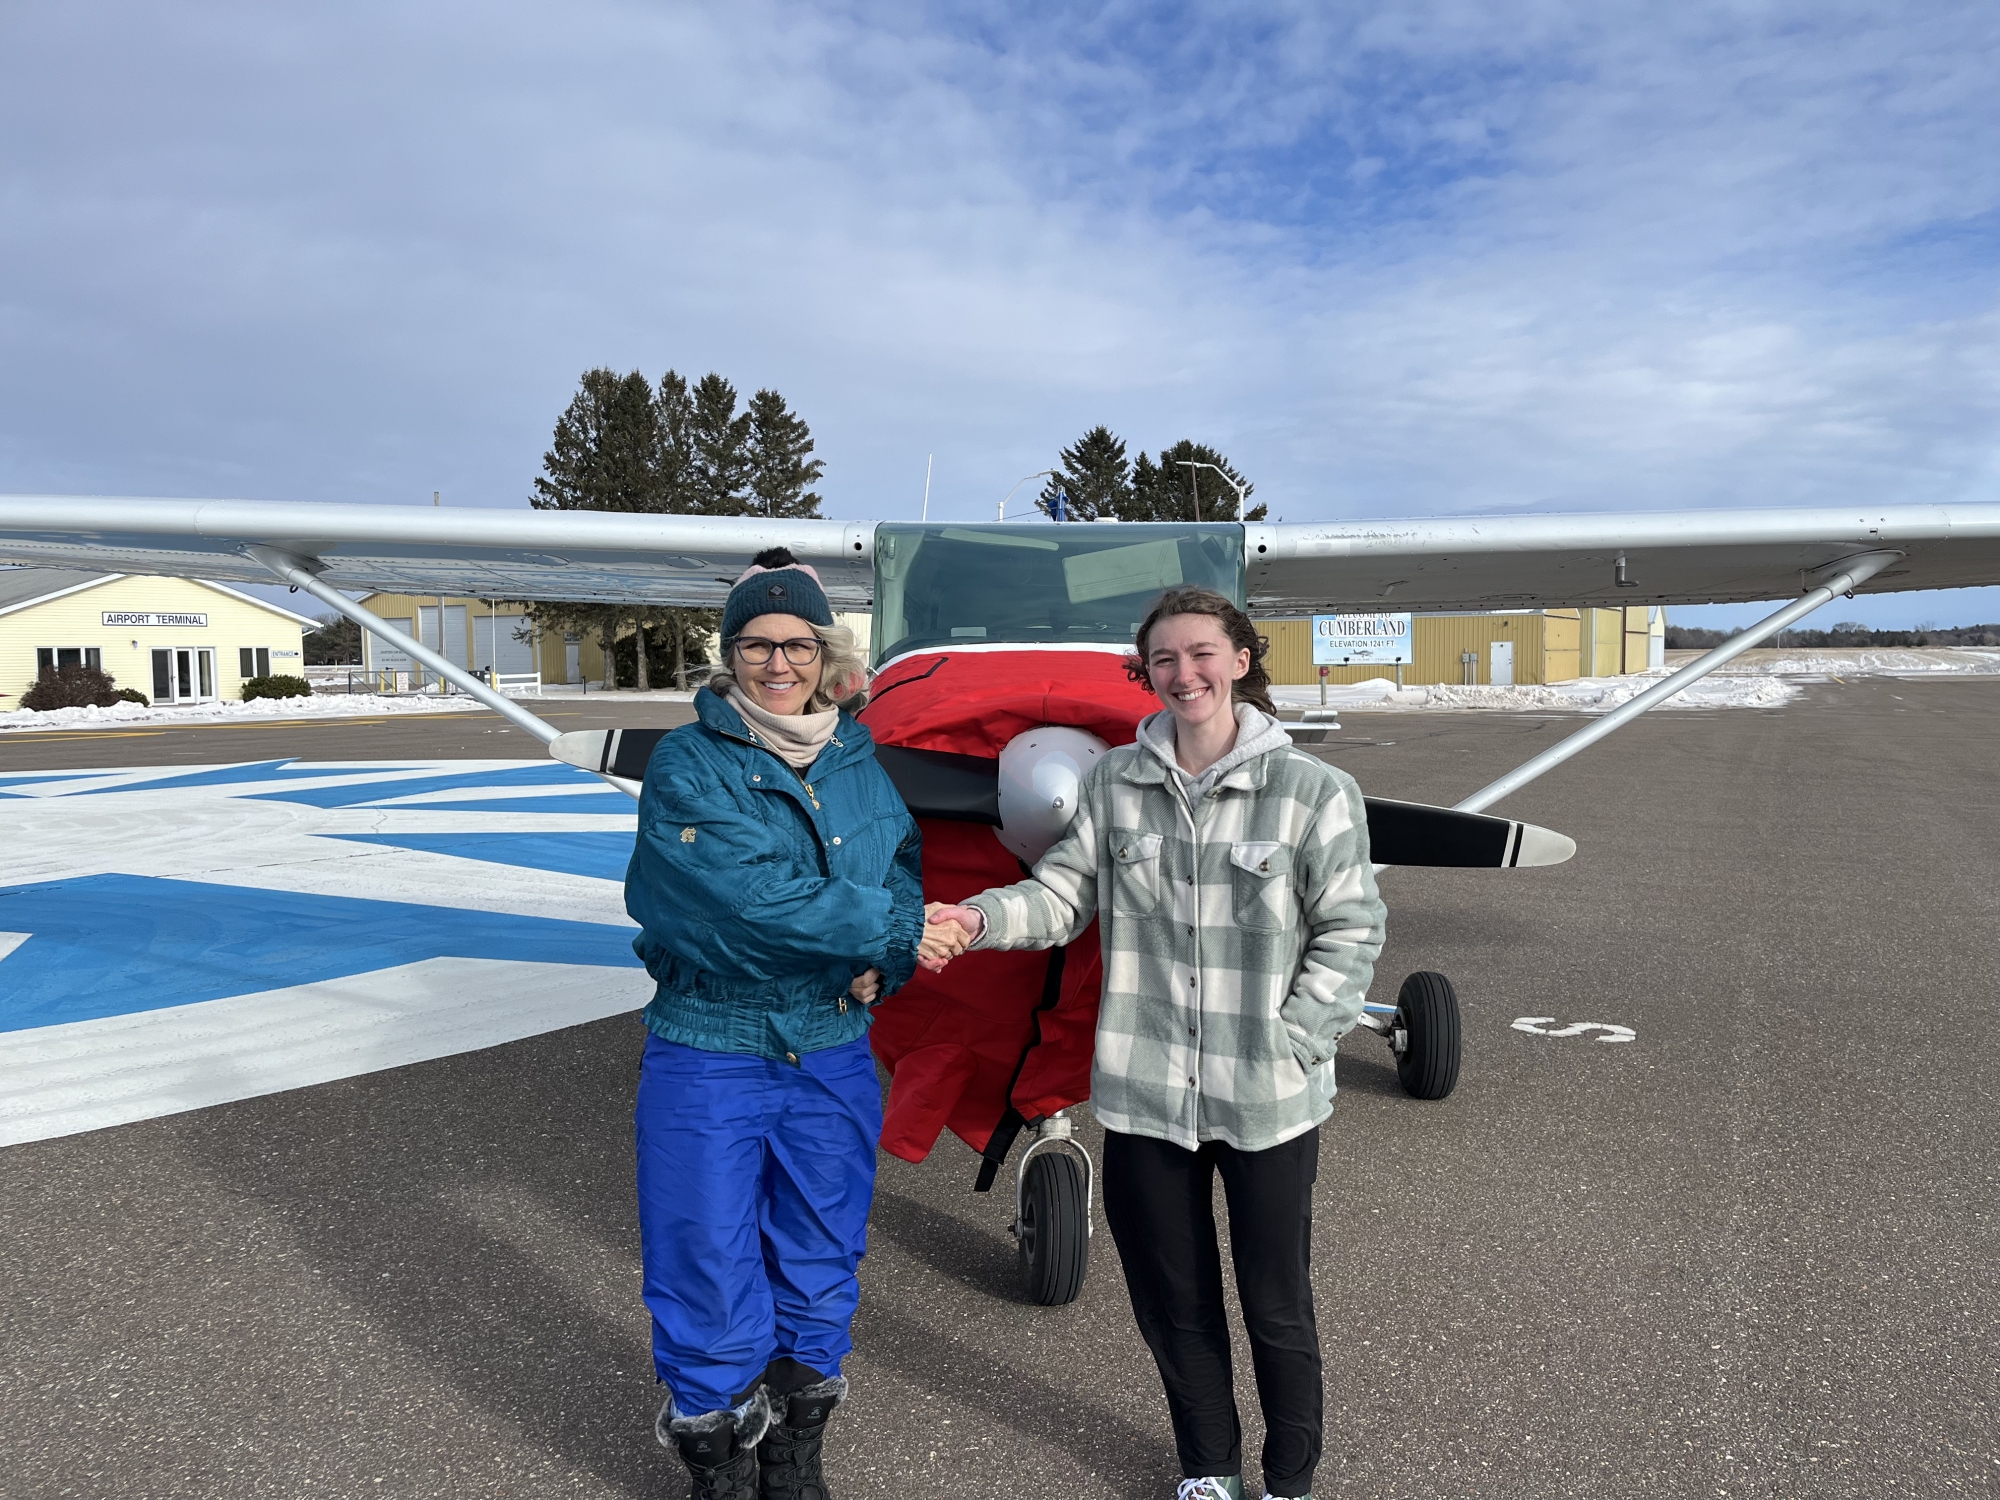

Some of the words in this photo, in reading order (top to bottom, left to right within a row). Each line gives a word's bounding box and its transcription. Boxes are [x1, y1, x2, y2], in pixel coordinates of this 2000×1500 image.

[106, 614, 150, 624] AIRPORT
[156, 615, 204, 625] TERMINAL
[1319, 620, 1405, 636] CUMBERLAND
[1329, 640, 1368, 648] ELEVATION
[1370, 640, 1384, 648] 1241
[1510, 1017, 1637, 1042] S
